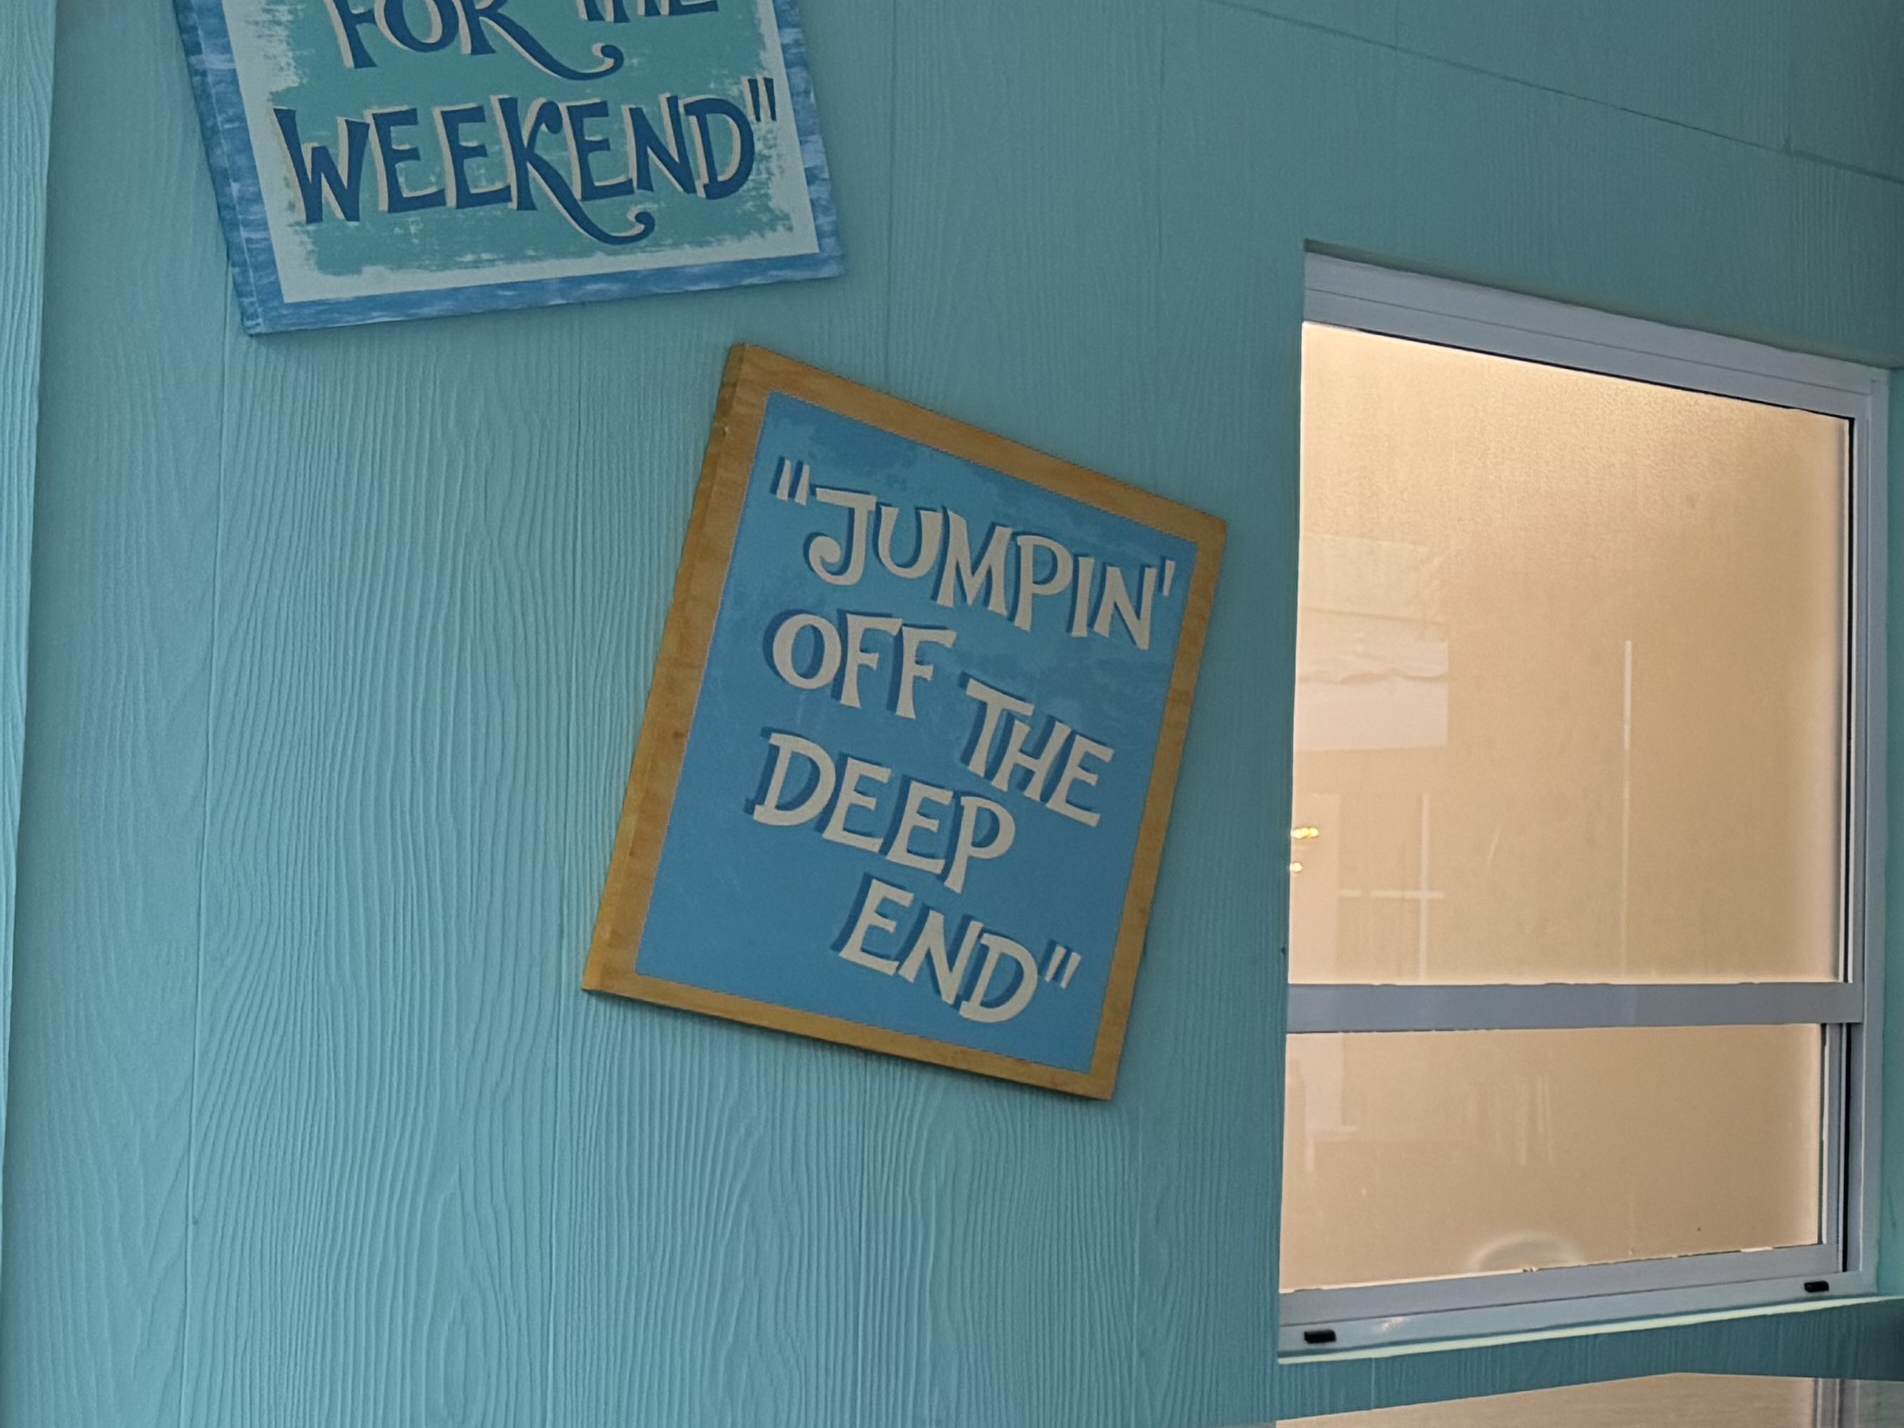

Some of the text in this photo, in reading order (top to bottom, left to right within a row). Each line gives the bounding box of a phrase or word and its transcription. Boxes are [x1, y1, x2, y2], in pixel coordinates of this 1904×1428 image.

[743, 726, 1017, 895] DEEP
[762, 608, 1115, 828] OFF THE
